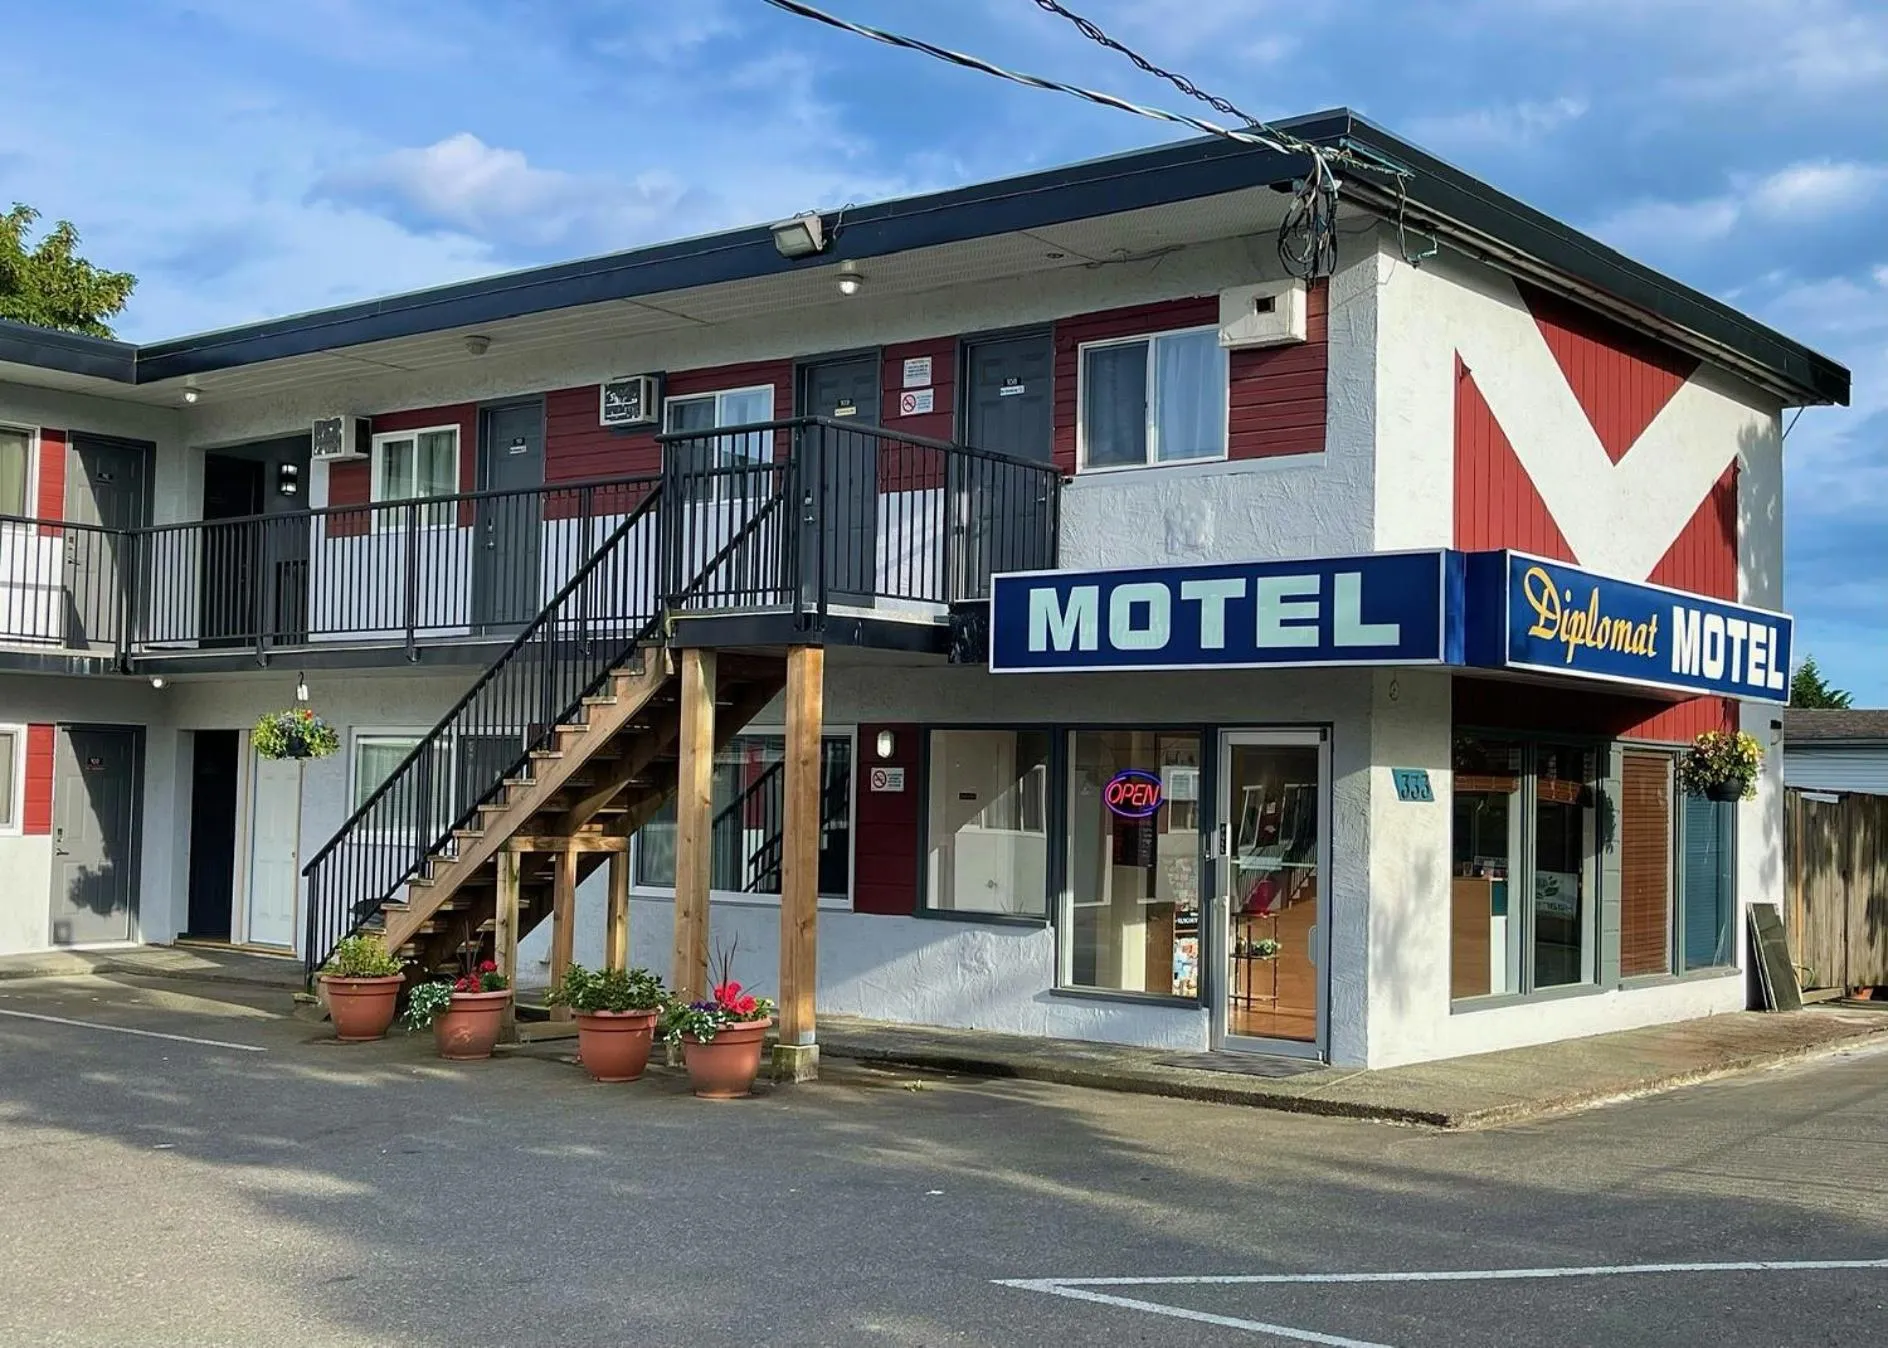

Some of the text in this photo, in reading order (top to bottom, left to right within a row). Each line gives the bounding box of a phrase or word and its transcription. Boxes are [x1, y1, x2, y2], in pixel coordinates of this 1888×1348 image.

[1028, 571, 1400, 652] MOTEL
[1523, 566, 1785, 690] Diplomat MOTEL
[1108, 783, 1160, 806] OPEN
[1401, 773, 1430, 800] 333
